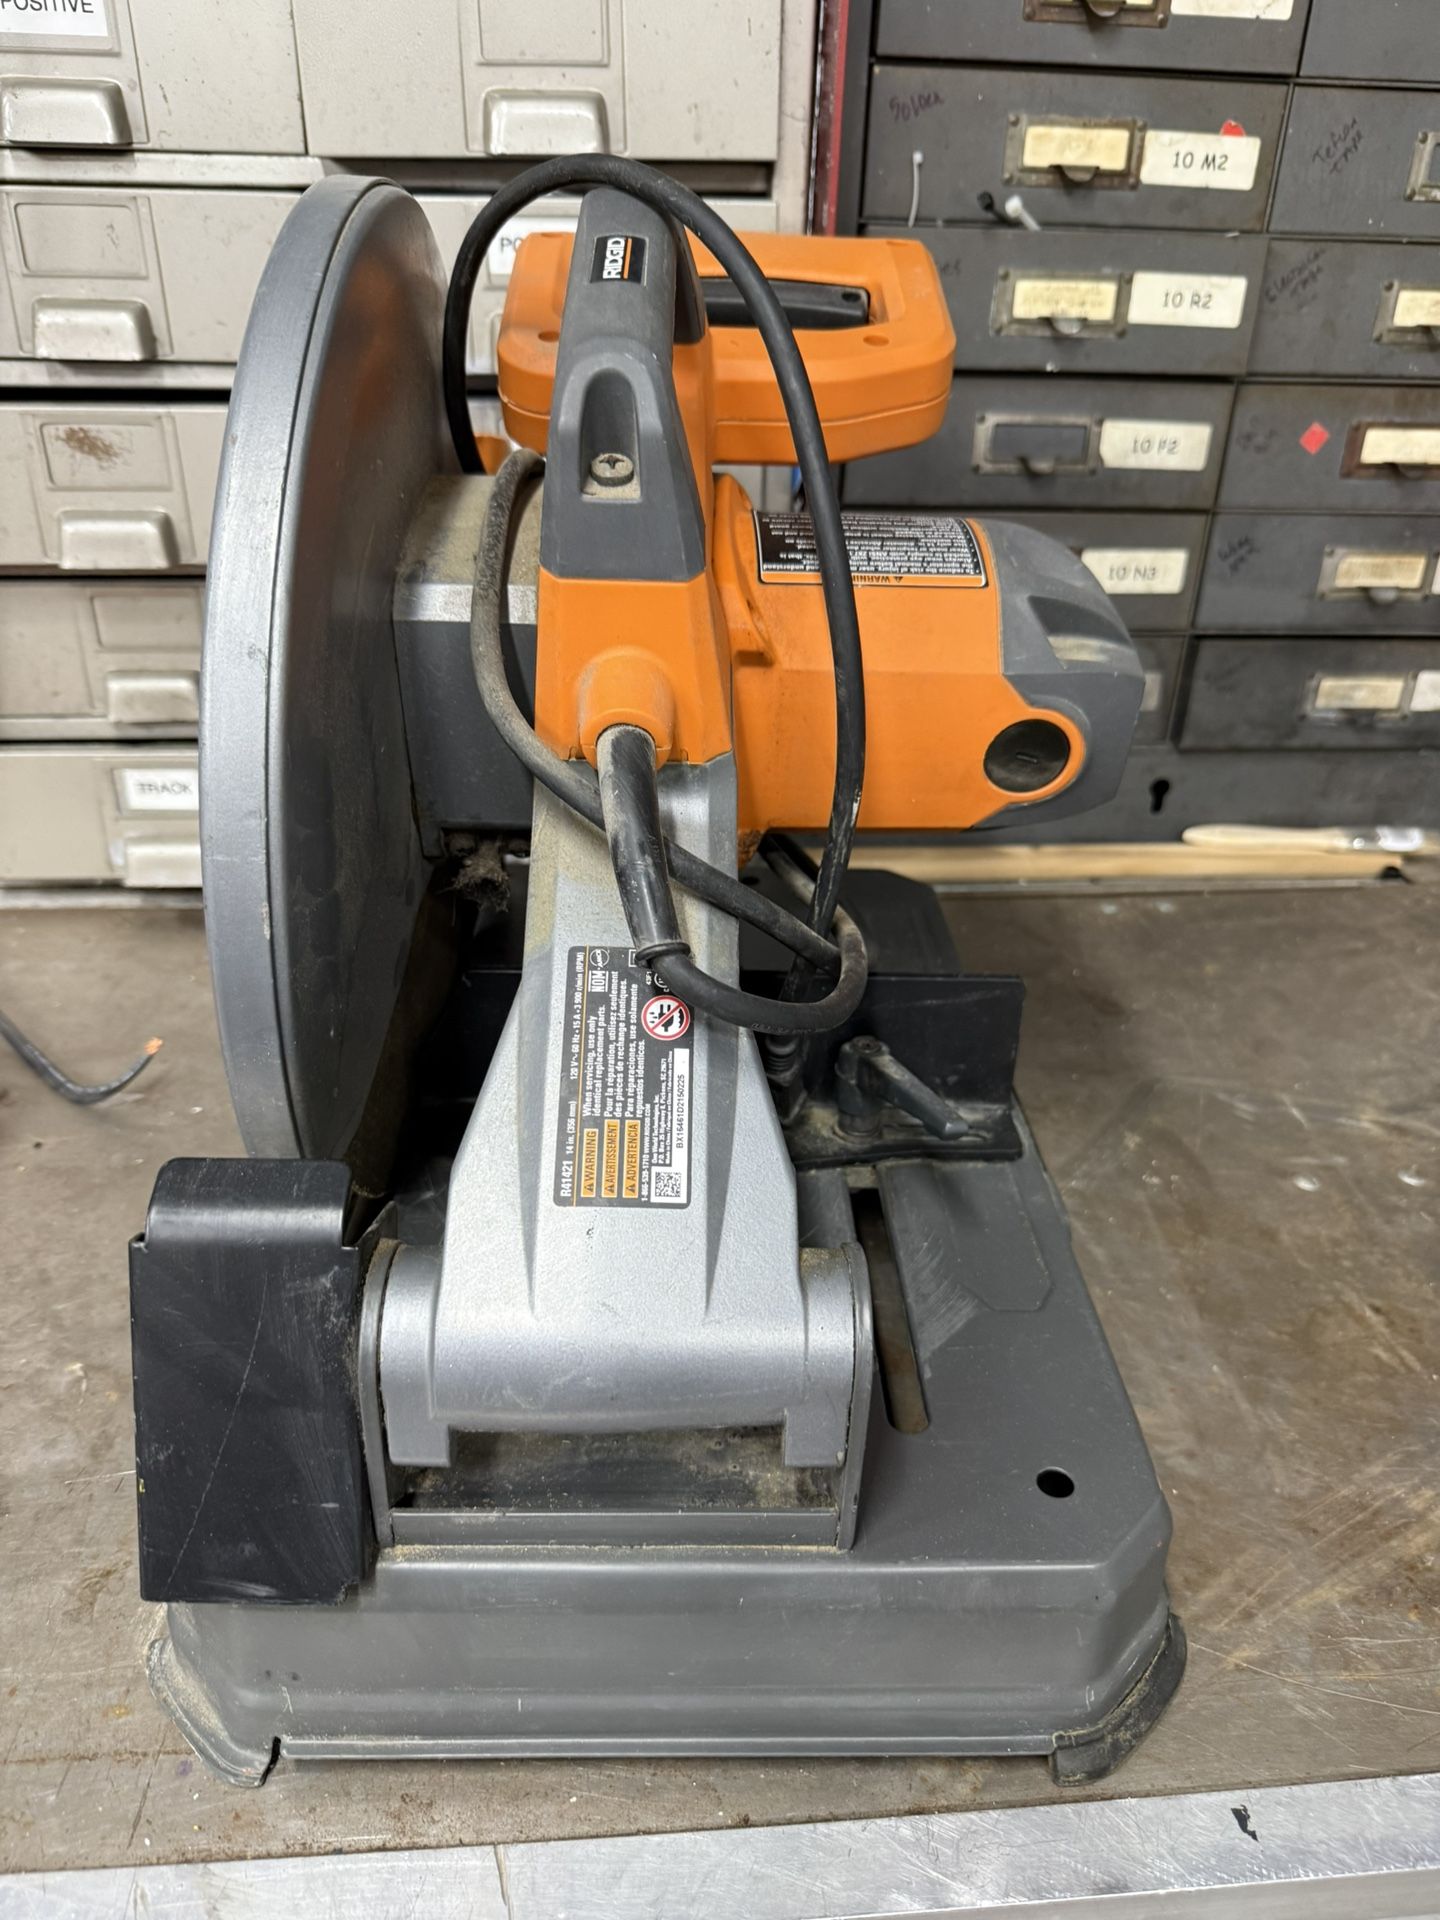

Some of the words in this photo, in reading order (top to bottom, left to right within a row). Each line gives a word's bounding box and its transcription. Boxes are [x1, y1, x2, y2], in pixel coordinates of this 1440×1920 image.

[0, 0, 94, 13] POSITIVE
[1172, 150, 1194, 169] 10
[1201, 153, 1229, 171] M2
[603, 237, 626, 279] RIDGID
[1163, 291, 1183, 308] 10
[1190, 292, 1213, 310] R2
[1132, 436, 1152, 454] 10
[1109, 566, 1127, 580] 10
[136, 782, 192, 794] TRACK
[576, 952, 584, 972] (RPM)
[575, 973, 583, 990] r/min
[591, 971, 605, 992] NOM
[609, 971, 618, 1010] seulement
[574, 992, 582, 1003] 900
[618, 979, 628, 1020] identiques.
[629, 984, 638, 1023] solamente
[587, 1016, 597, 1032] only
[597, 1005, 606, 1026] parts.
[608, 1012, 616, 1040] utilisez
[572, 1034, 580, 1043] Hz
[572, 1044, 579, 1052] 60
[616, 1022, 627, 1059] rechange
[594, 1028, 605, 1078] replacement
[585, 1050, 596, 1090] servicing,
[605, 1042, 616, 1086] réparation,
[615, 1061, 623, 1071] de
[570, 1068, 578, 1080] 120
[592, 1080, 601, 1116] identical
[605, 1088, 613, 1096] la
[636, 1079, 644, 1117] repuestos
[568, 1101, 577, 1117] mm)
[583, 1092, 592, 1116] When
[604, 1098, 613, 1117] Pour
[614, 1102, 622, 1117] des
[625, 1098, 634, 1117] Para
[566, 1118, 576, 1134] (356
[566, 1134, 575, 1144] in.
[566, 1145, 574, 1154] 14
[584, 1131, 596, 1182] WARNING
[605, 1123, 617, 1183] AVERTISSEMENT
[626, 1124, 638, 1181] ADVERTENCIA
[560, 1161, 572, 1196] R41421
